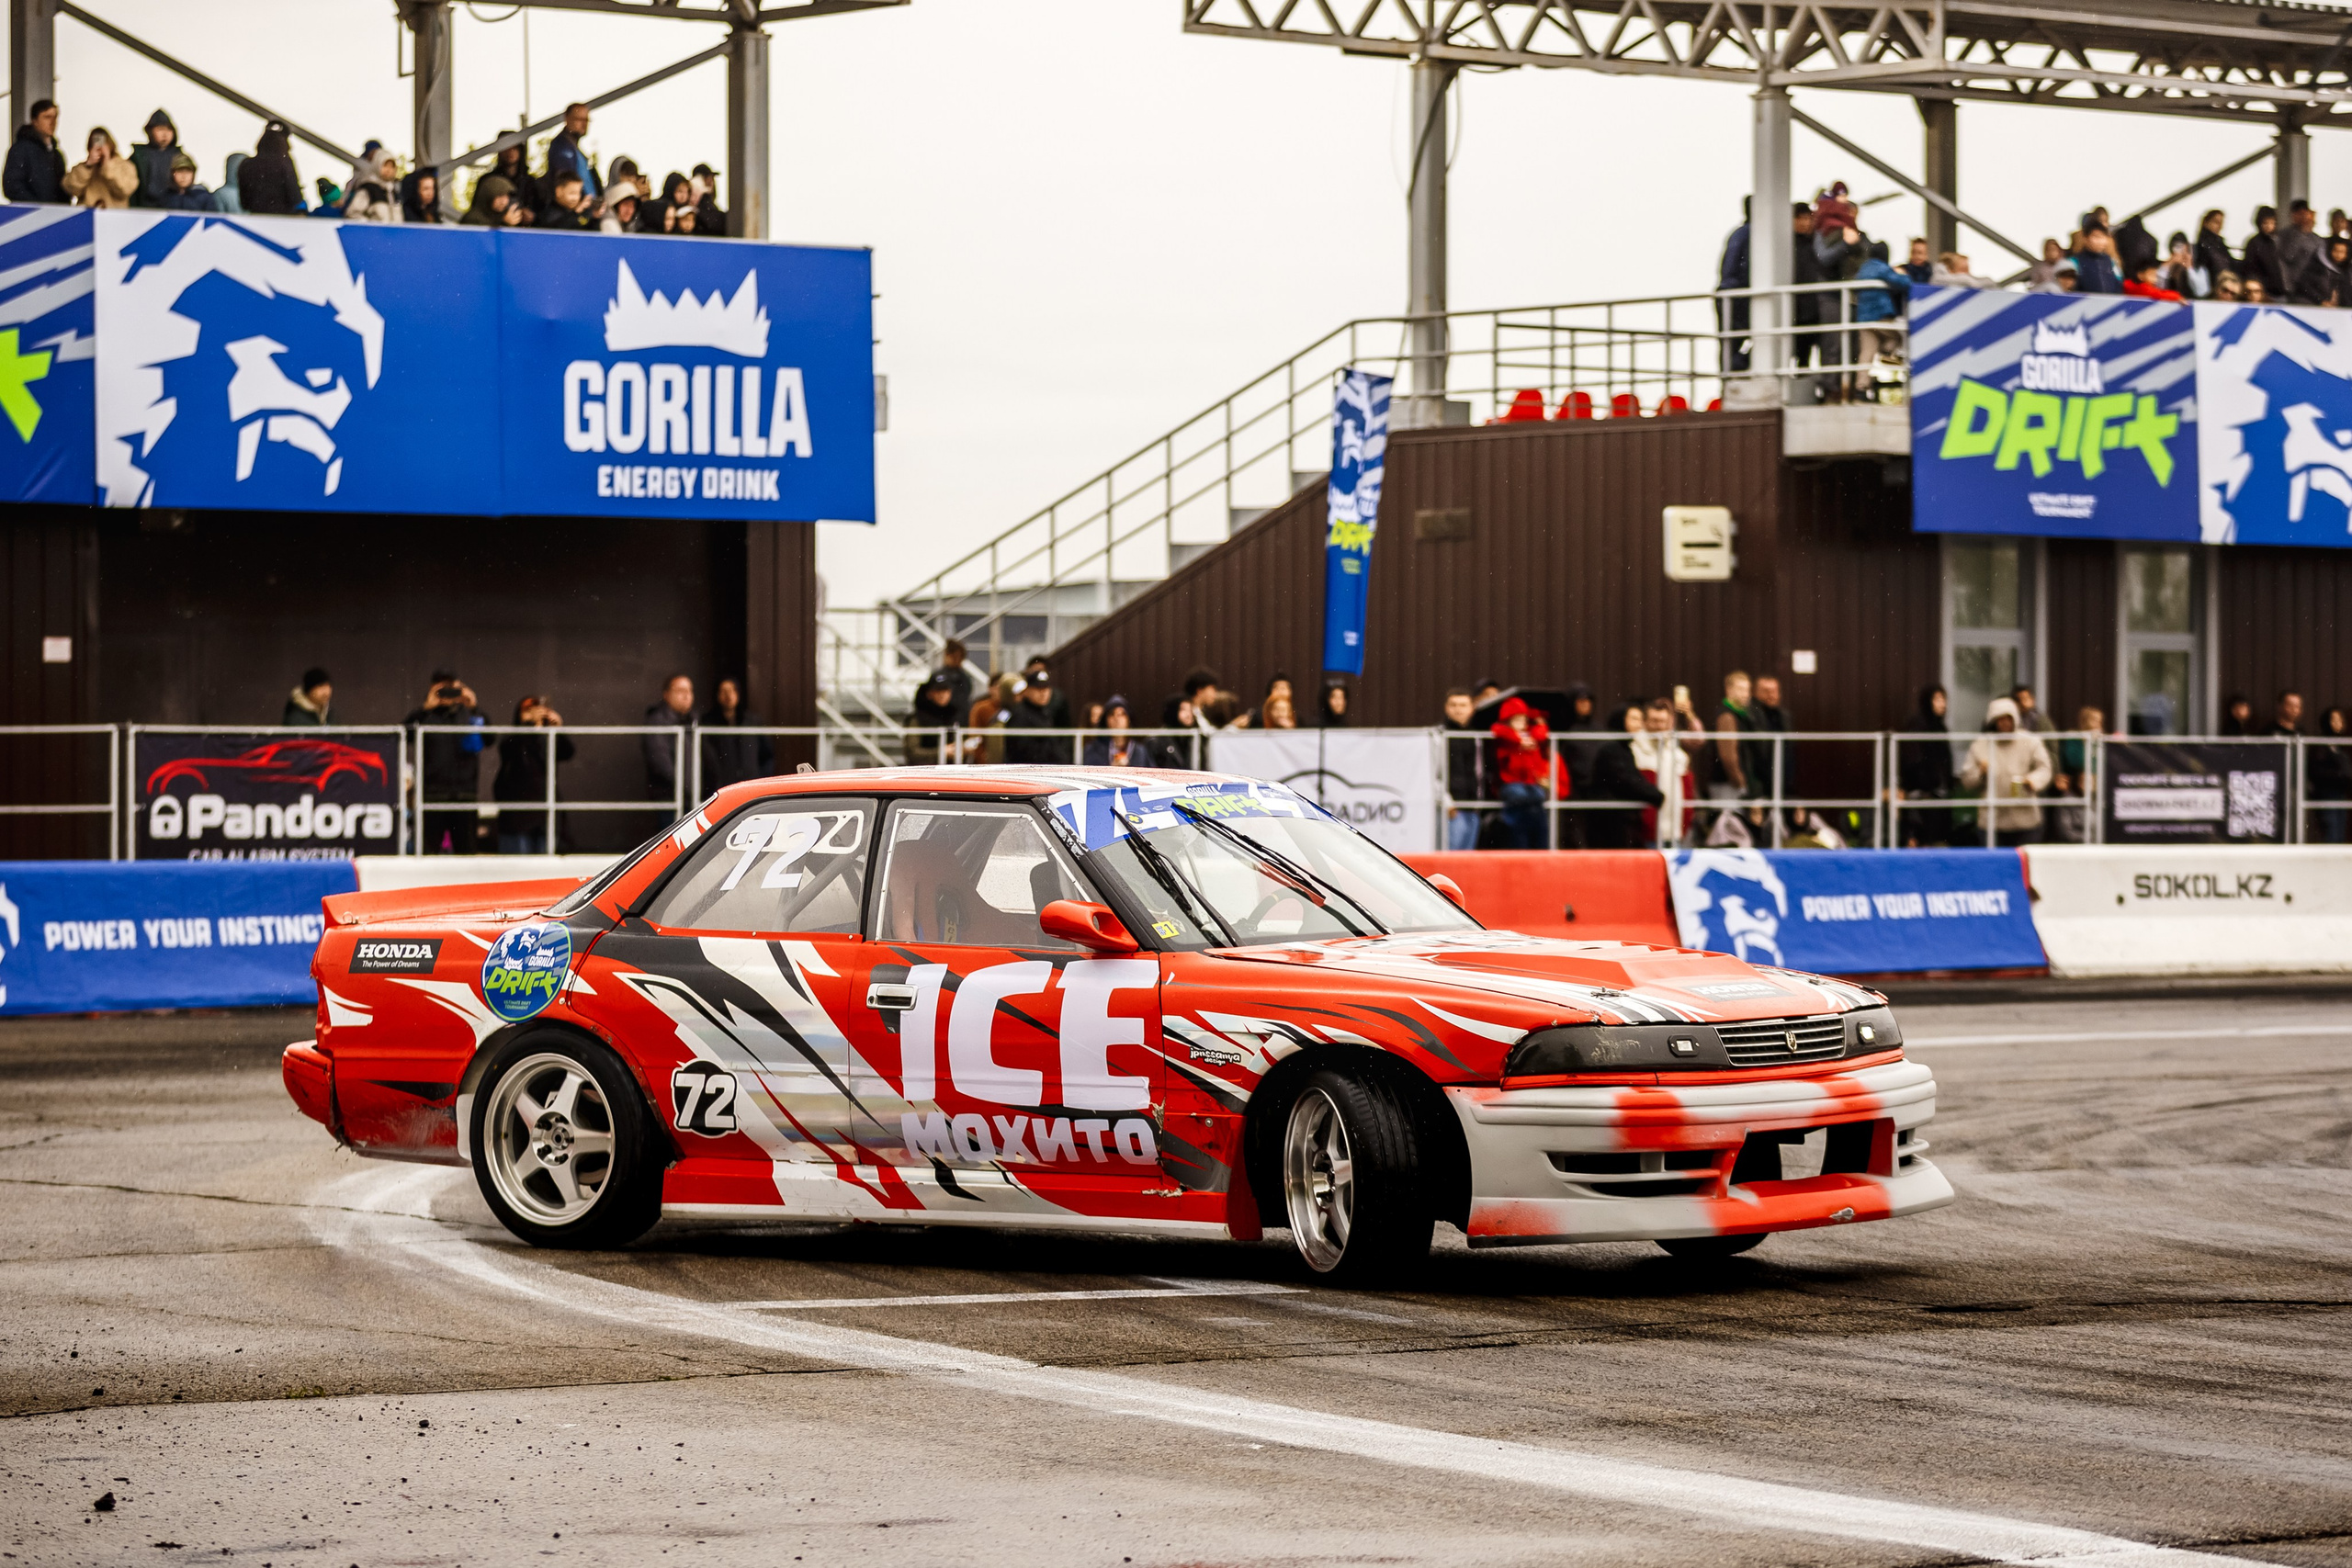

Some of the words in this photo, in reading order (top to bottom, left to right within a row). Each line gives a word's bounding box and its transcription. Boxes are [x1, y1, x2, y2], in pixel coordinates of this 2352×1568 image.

[2021, 354, 2104, 393] GORILLA
[563, 359, 813, 458] GORILLA
[1939, 378, 2180, 488] DRIFT
[597, 464, 698, 499] ENERGY
[702, 467, 780, 502] DRINK
[1173, 795, 1273, 818] DRIFT
[1186, 784, 1221, 796] GORILLA
[187, 794, 393, 840] Pandora
[719, 817, 821, 891] 72
[2133, 873, 2274, 899] SOKOL.KZ
[1802, 894, 1871, 922] POWER
[1872, 892, 1926, 920] YOUR
[1926, 889, 2010, 919] INSTINCT
[44, 919, 137, 952] POWER
[142, 917, 212, 949] YOUR
[357, 943, 433, 958] HONDA
[373, 960, 390, 968] Power
[527, 955, 555, 968] GORILLA
[485, 966, 558, 999] DRIFT
[899, 959, 1160, 1111] ICE
[1204, 1057, 1226, 1066] design
[674, 1073, 735, 1129] 72
[900, 1111, 1161, 1166] МОХИТО
